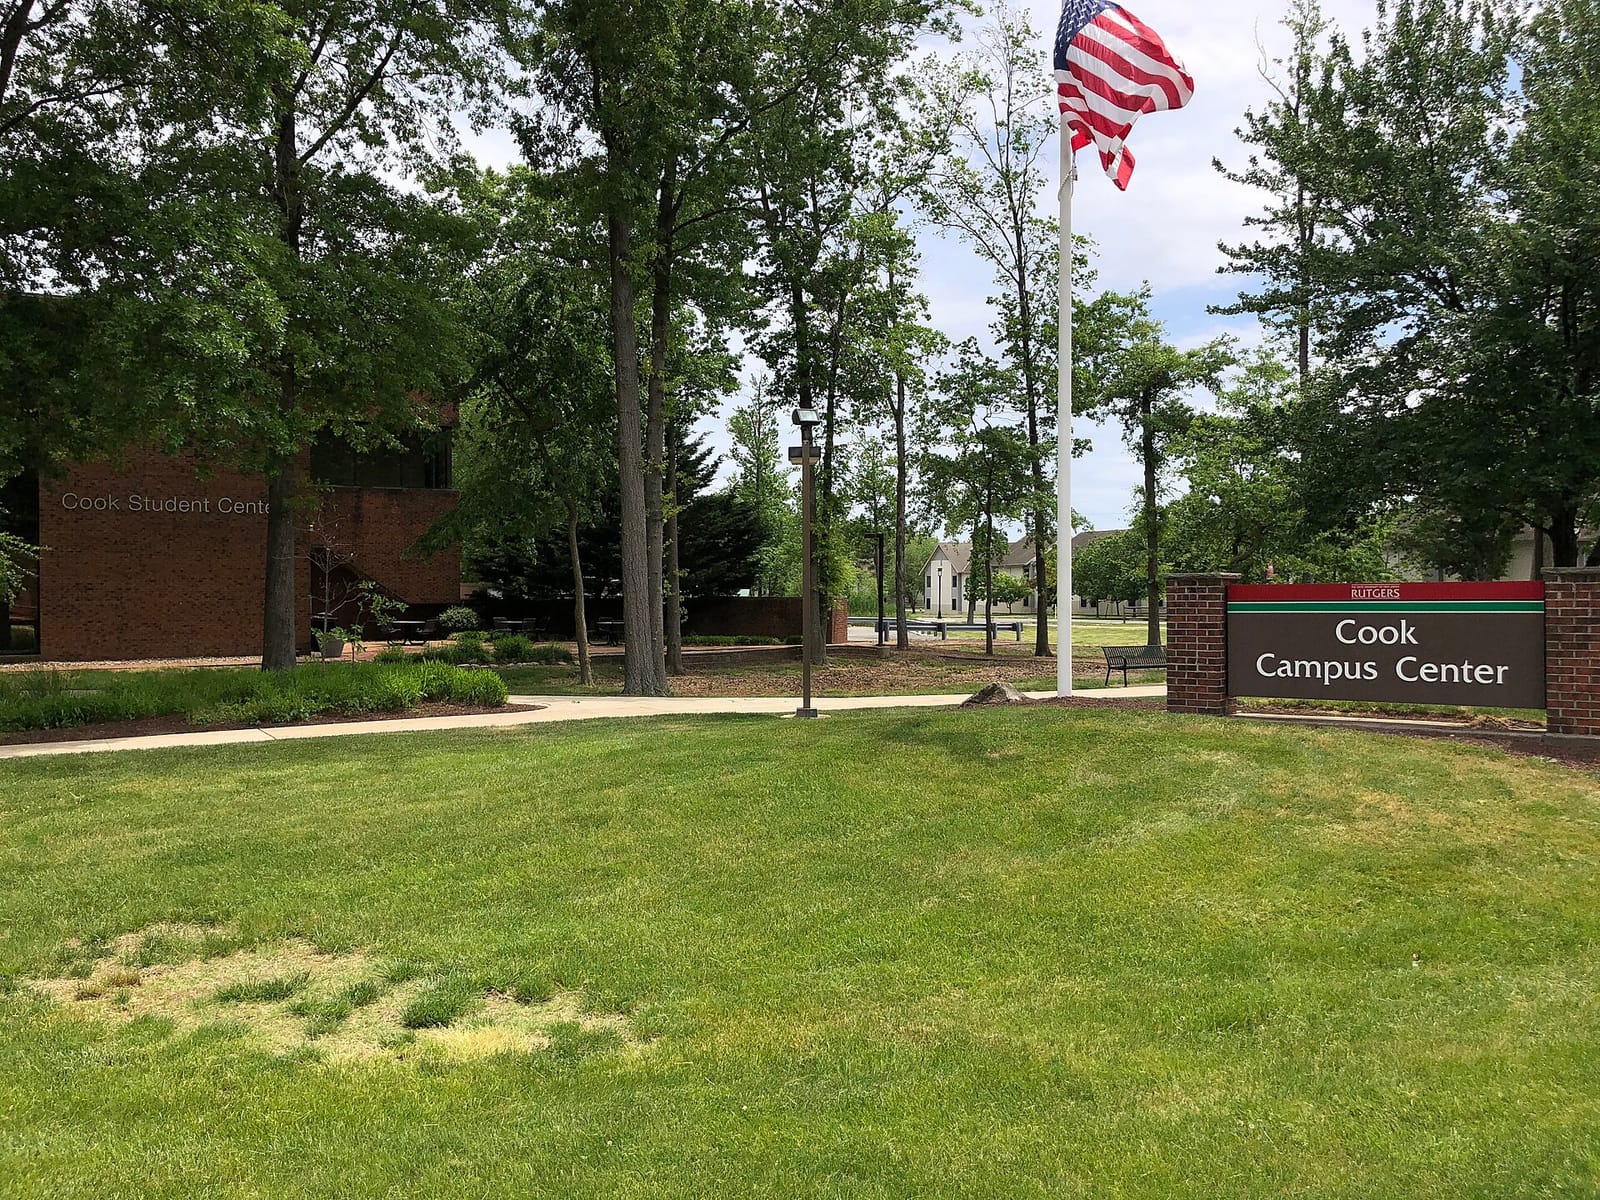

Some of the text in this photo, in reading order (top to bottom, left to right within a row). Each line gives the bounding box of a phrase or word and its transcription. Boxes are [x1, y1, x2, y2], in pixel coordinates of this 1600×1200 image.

[62, 493, 120, 510] Cook
[128, 494, 210, 513] Student
[1351, 588, 1400, 598] RUTGERS
[1335, 618, 1419, 645] Cook
[1256, 653, 1509, 685] Campus Center
